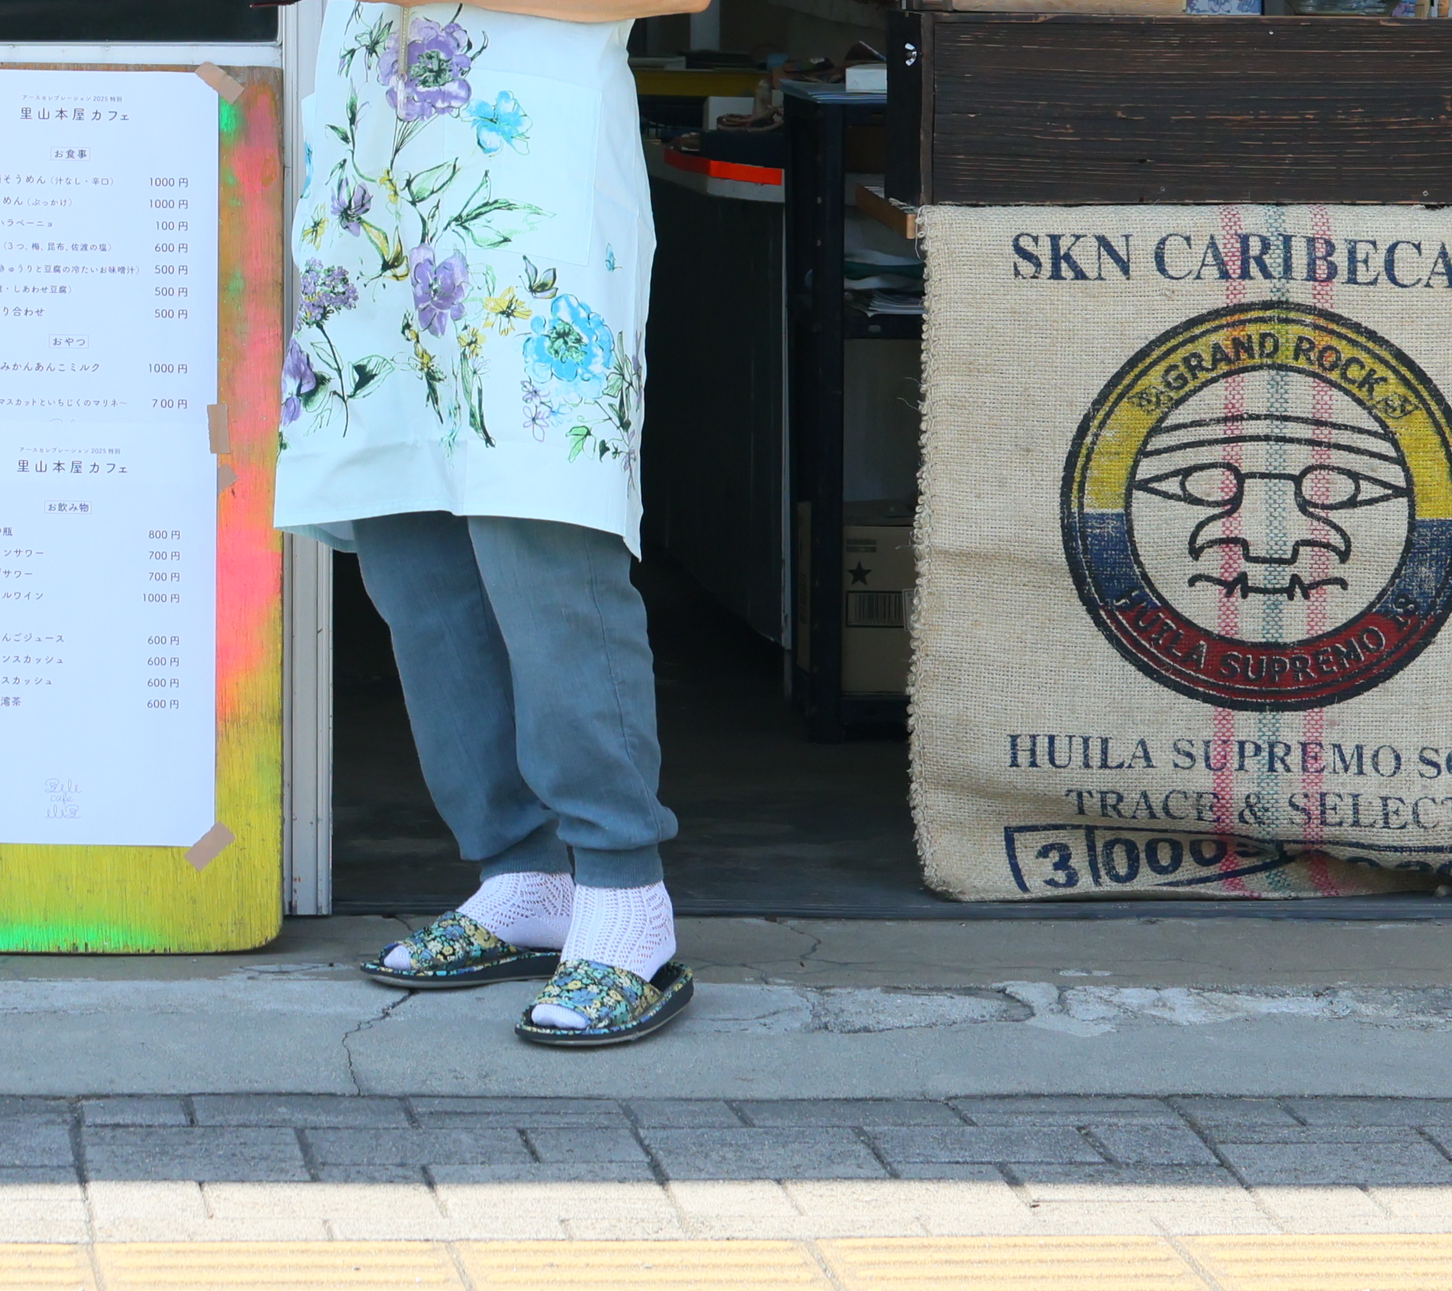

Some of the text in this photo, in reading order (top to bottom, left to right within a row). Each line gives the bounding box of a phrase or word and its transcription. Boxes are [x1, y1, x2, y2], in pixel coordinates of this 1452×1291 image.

[55, 149, 87, 159] お食事
[1012, 232, 1133, 281] SKN
[53, 338, 85, 346] おやつ
[1161, 331, 1388, 400] GRAND ROCK
[48, 503, 89, 512] お飲み物
[1222, 625, 1386, 682] SUPREMO
[1006, 734, 1156, 771] HUILA
[1171, 735, 1401, 778] SUPREMO
[1065, 788, 1221, 824] TRACE
[1237, 793, 1264, 826] &
